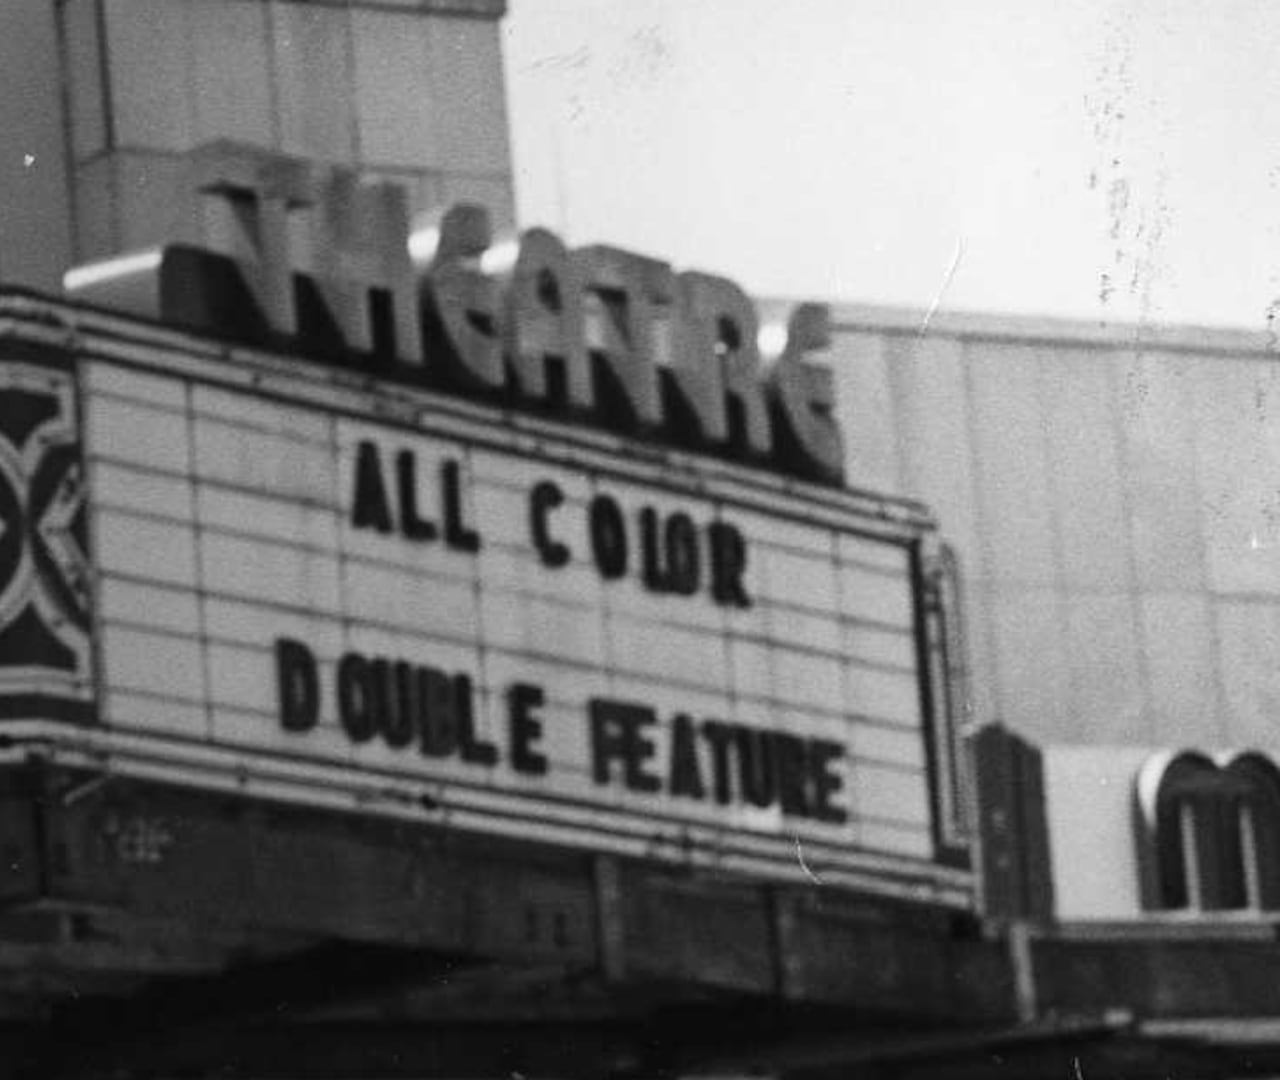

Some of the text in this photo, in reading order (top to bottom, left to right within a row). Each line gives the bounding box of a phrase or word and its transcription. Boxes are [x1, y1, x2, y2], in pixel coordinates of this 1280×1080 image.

[351, 440, 753, 610] ALL COLOR
[275, 638, 849, 826] DOUBLE FEATURE
